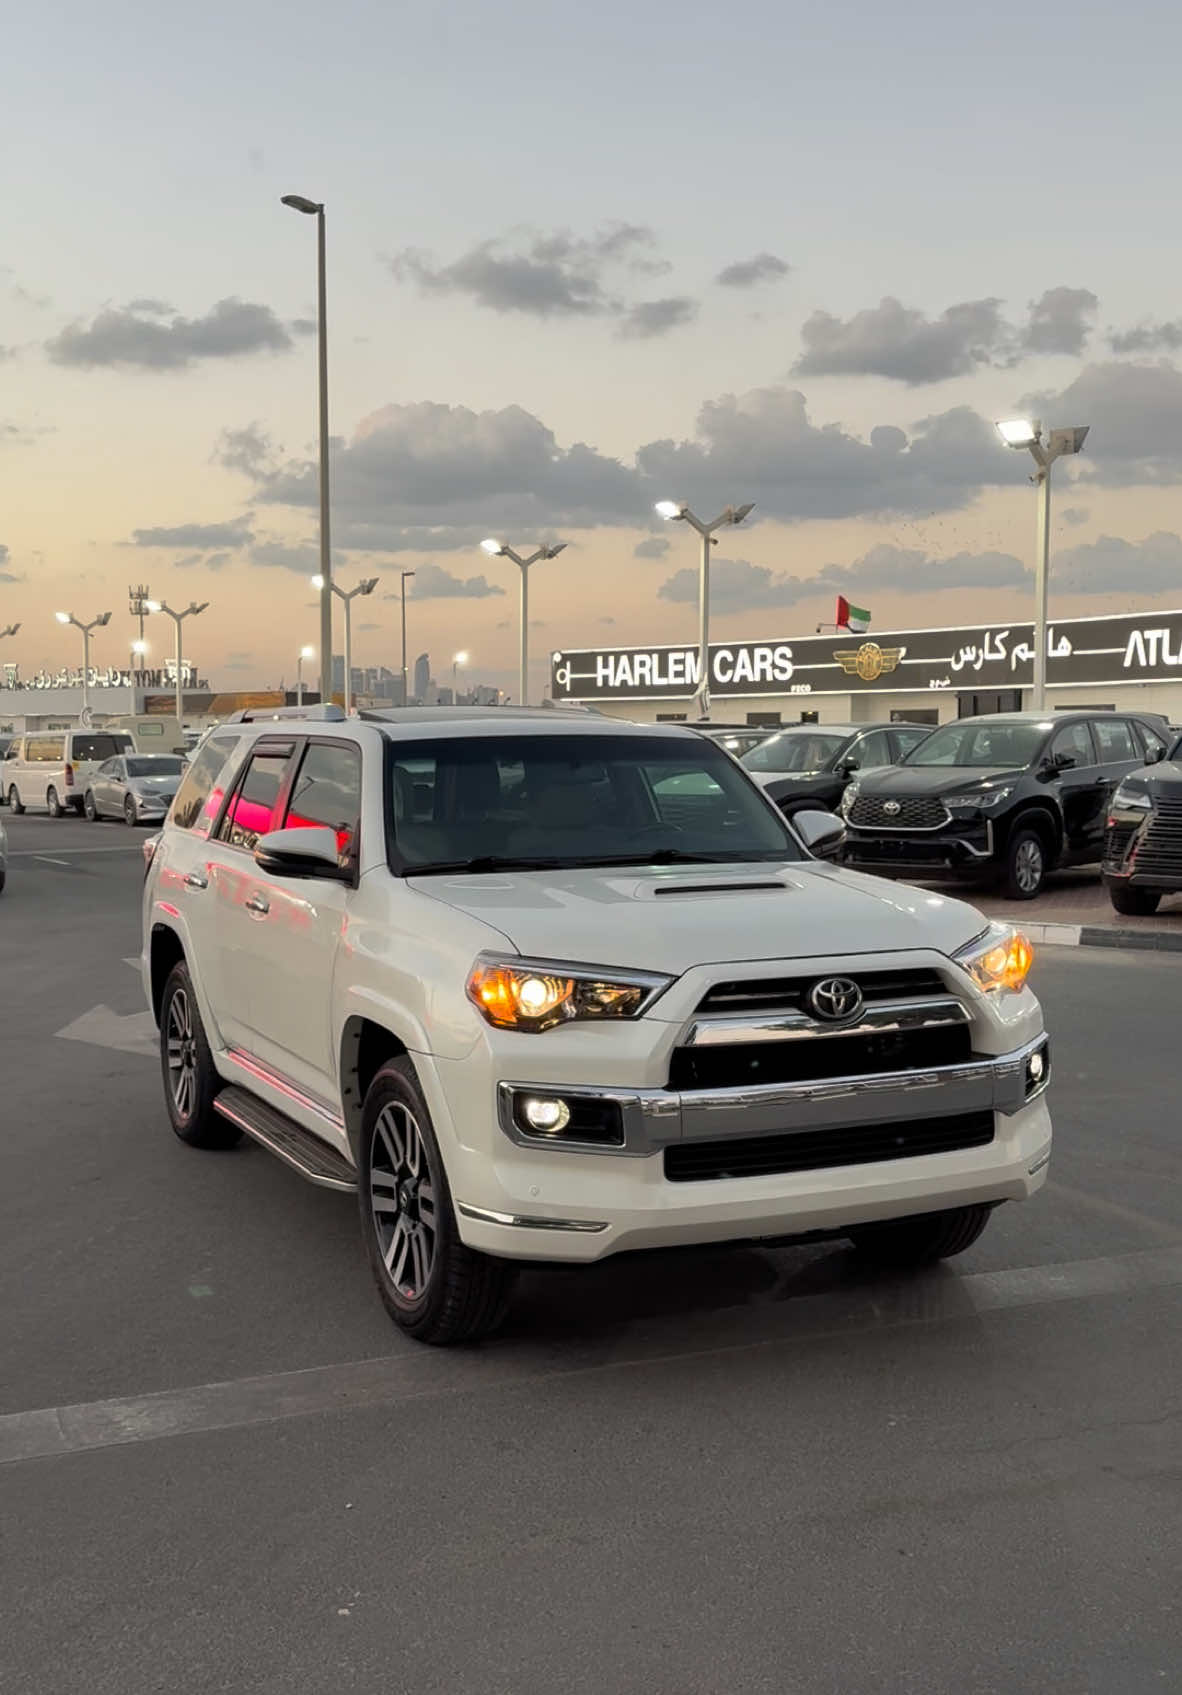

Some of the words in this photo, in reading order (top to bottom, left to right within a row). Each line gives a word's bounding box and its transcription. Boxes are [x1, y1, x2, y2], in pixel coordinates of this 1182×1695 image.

[596, 652, 702, 687] HARLEM
[713, 646, 793, 683] CARS
[1123, 628, 1182, 667] ATL
